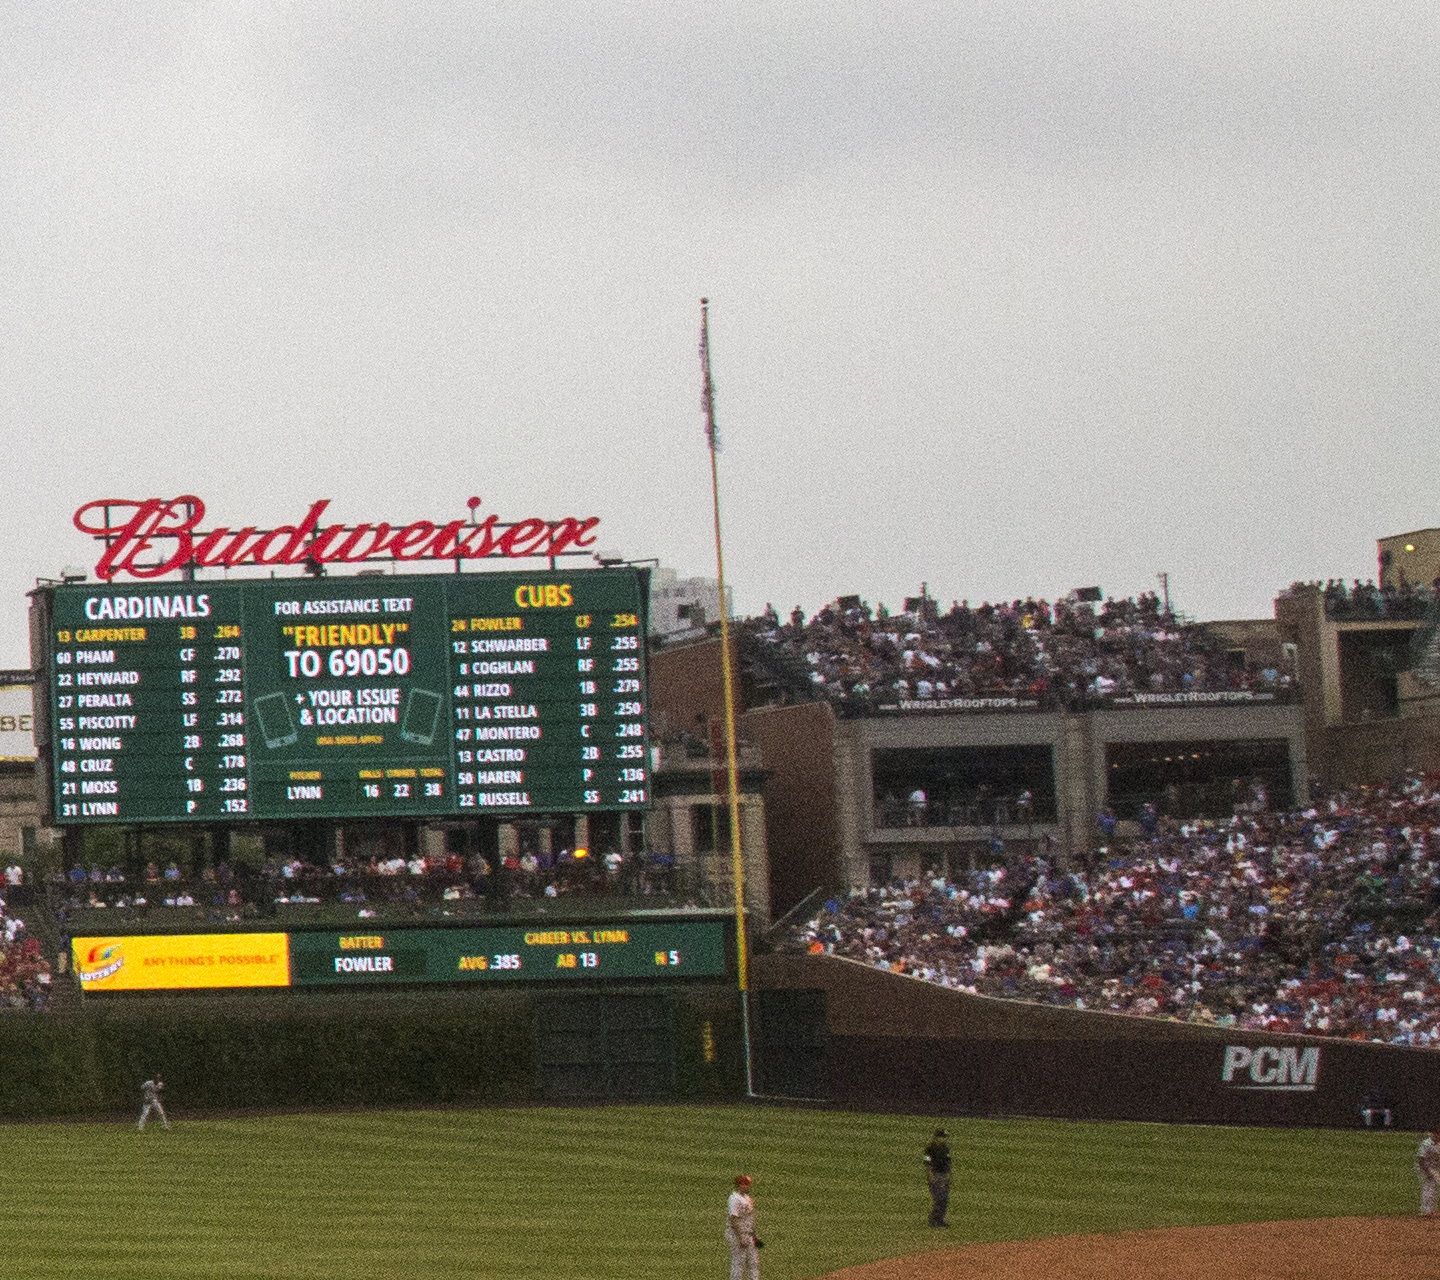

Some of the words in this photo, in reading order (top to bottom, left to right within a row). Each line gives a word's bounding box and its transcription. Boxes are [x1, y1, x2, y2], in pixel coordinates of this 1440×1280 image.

[73, 495, 600, 580] Budweiser
[515, 584, 574, 608] CUBS
[84, 594, 211, 620] CARDINALS
[274, 601, 301, 615] FOR
[303, 599, 379, 614] ASSISTANCE
[382, 597, 413, 612] TEXT
[75, 628, 146, 642] CARPENTER
[282, 623, 409, 646] "FRIENDLY"
[471, 638, 549, 652] SCHWARBER
[76, 650, 116, 663] PHAM
[214, 647, 241, 660] .270
[284, 650, 322, 677] TO
[329, 648, 411, 676] 69050
[472, 660, 535, 675] COGHLAN
[77, 671, 140, 685] HEYWARD
[473, 683, 512, 697] RIZZO
[78, 694, 133, 707] PERALTA
[308, 690, 353, 707] YOUR
[357, 688, 401, 705] ISSUE
[300, 709, 313, 725] &
[316, 707, 398, 725] LOCATION
[456, 708, 471, 719] 11
[474, 706, 493, 719] LA
[494, 705, 539, 718] STELLA
[79, 715, 136, 729] PISCOTTY
[475, 726, 542, 740] MONTERO
[79, 737, 122, 750] WONG
[476, 748, 527, 763] CASTRO
[80, 759, 113, 772] CRUZ
[478, 771, 524, 784] HAREN
[82, 781, 119, 794] MOSS
[287, 786, 323, 799] LYNN
[364, 785, 380, 797] 16
[393, 783, 411, 797] 22
[459, 794, 476, 806] 22
[479, 792, 531, 806] RUSSELL
[63, 804, 77, 816] 31
[82, 802, 118, 816] LYNN
[334, 956, 393, 973] FOWLER
[490, 954, 521, 970] .385
[580, 952, 599, 968] 13
[669, 950, 680, 965] 5
[1222, 1045, 1319, 1083] PCM
